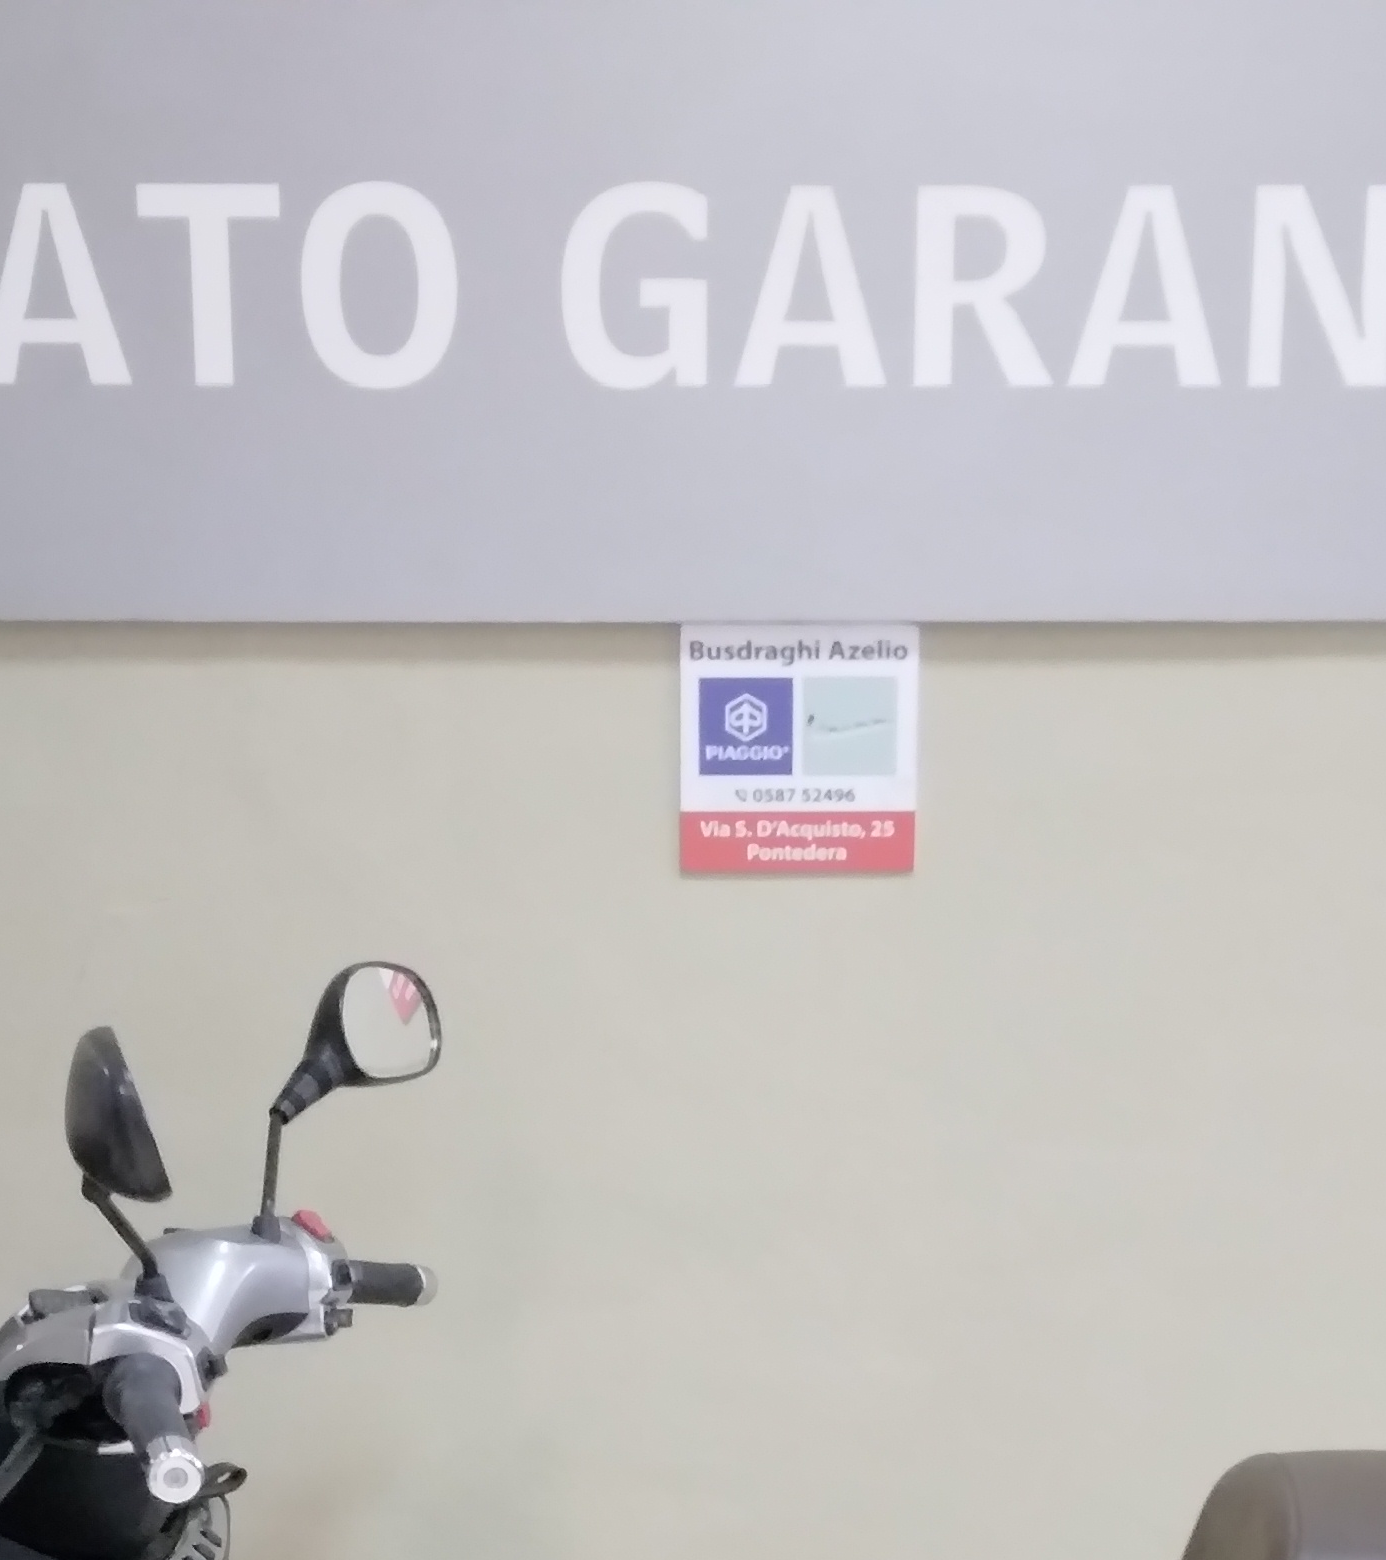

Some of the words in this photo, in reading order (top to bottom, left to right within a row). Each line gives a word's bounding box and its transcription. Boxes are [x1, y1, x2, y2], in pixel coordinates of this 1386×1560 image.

[689, 640, 820, 666] Busdraghi
[828, 640, 908, 661] Azelio
[752, 788, 796, 802] 0587
[801, 788, 856, 802] 52496
[700, 820, 732, 838] Via
[735, 820, 752, 838] S.
[870, 820, 895, 837] 25
[746, 843, 847, 861] Pontedera
